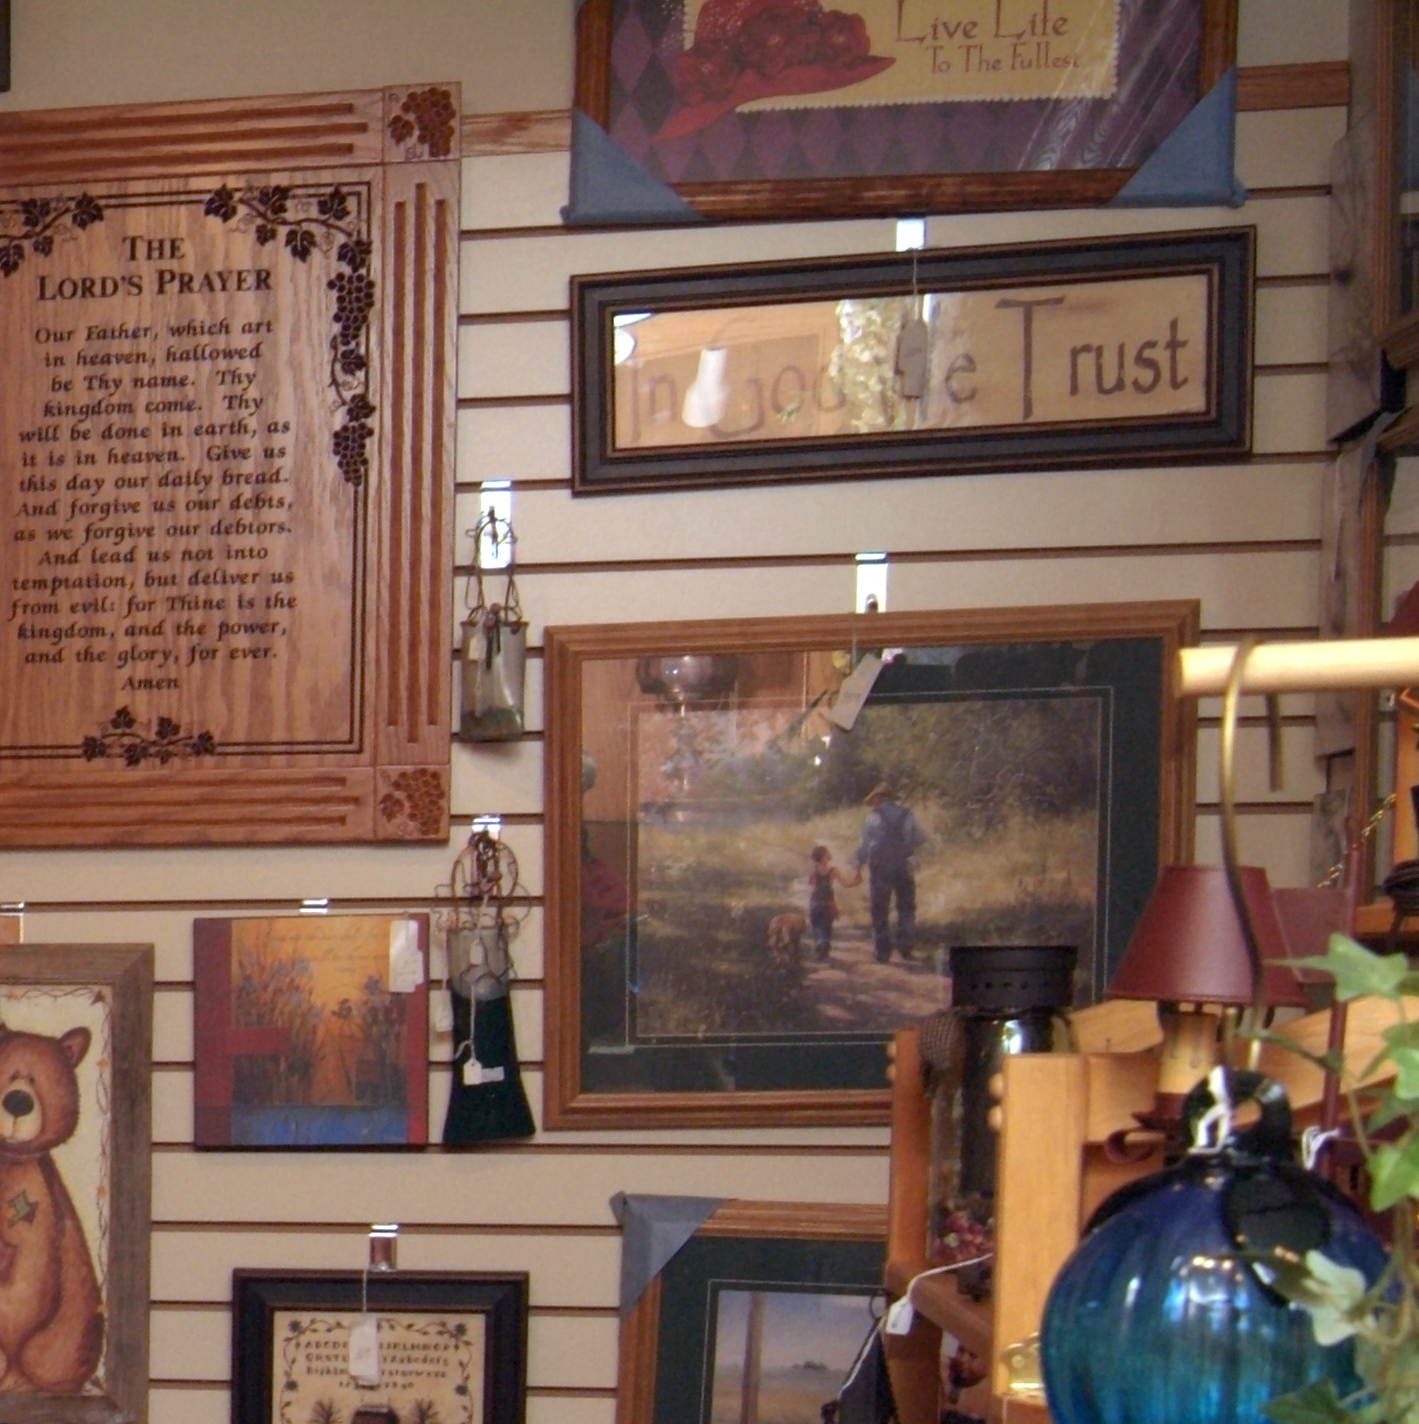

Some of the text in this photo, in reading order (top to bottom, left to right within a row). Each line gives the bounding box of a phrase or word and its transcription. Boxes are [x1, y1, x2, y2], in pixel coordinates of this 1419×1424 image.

[895, 0, 980, 44] Live
[924, 41, 1081, 73] To The Fullest
[121, 234, 186, 262] THE
[36, 268, 273, 301] LORD'S PRAYER
[34, 317, 274, 344] Our Father, which art
[44, 340, 264, 368] in heaven, hallowed
[994, 295, 1190, 422] Trust
[51, 368, 257, 397] be Thy name. Thy
[43, 393, 264, 424] kingdom come. Thy
[18, 419, 291, 443] will be done in earth, as
[22, 445, 286, 468] it is in heaven. Give us
[19, 467, 289, 497] this day our daily bread.
[16, 492, 293, 520] And forgive us our debts,
[13, 518, 292, 546] as we forgive our debtors.
[37, 545, 269, 566] And lead us not into
[11, 568, 295, 596] temptation, but deliver us
[6, 592, 298, 623] from evil: for Thine is the
[17, 619, 287, 646] kingdom, and the power,
[24, 645, 277, 670] and the glory, for ever.
[121, 676, 179, 691] Amen
